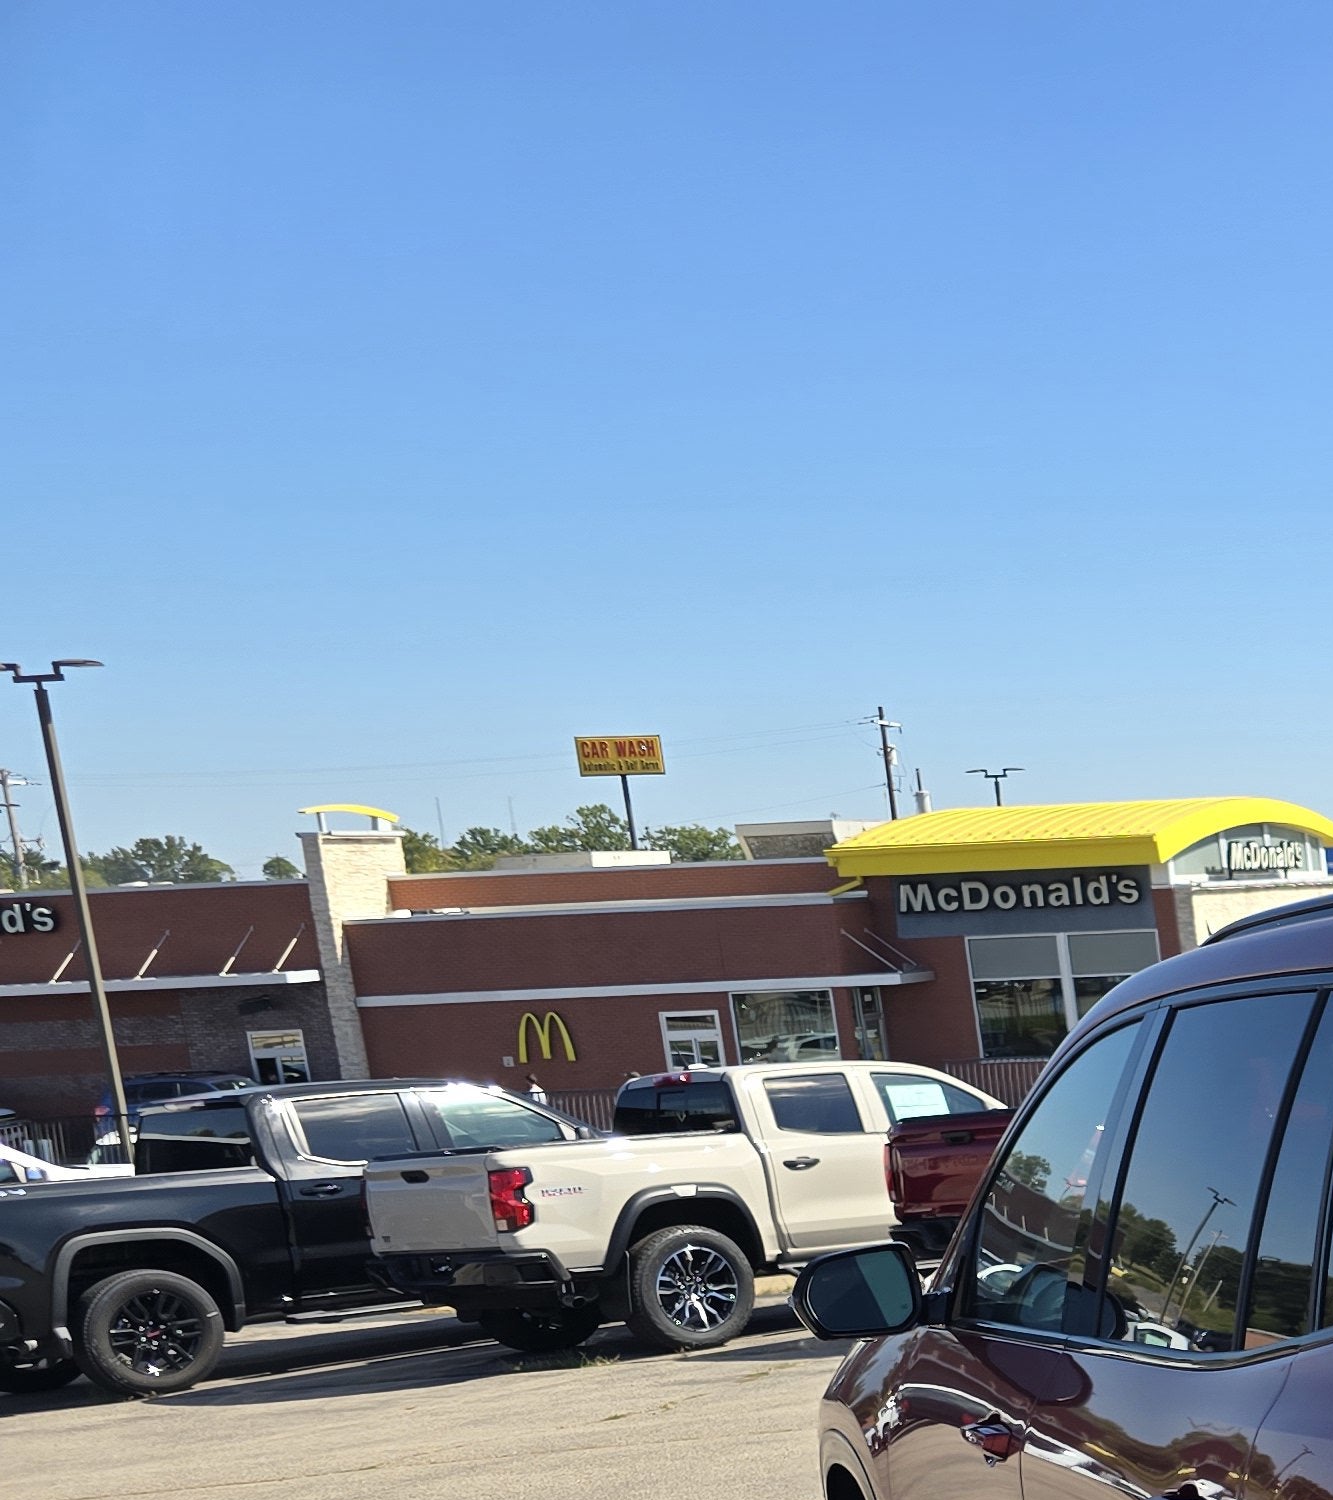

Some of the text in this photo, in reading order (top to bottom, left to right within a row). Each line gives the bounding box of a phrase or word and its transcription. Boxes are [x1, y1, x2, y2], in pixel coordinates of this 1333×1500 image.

[581, 739, 656, 758] CAR WASH
[1230, 841, 1304, 870] McDonald's
[899, 875, 1140, 912] McDonald's
